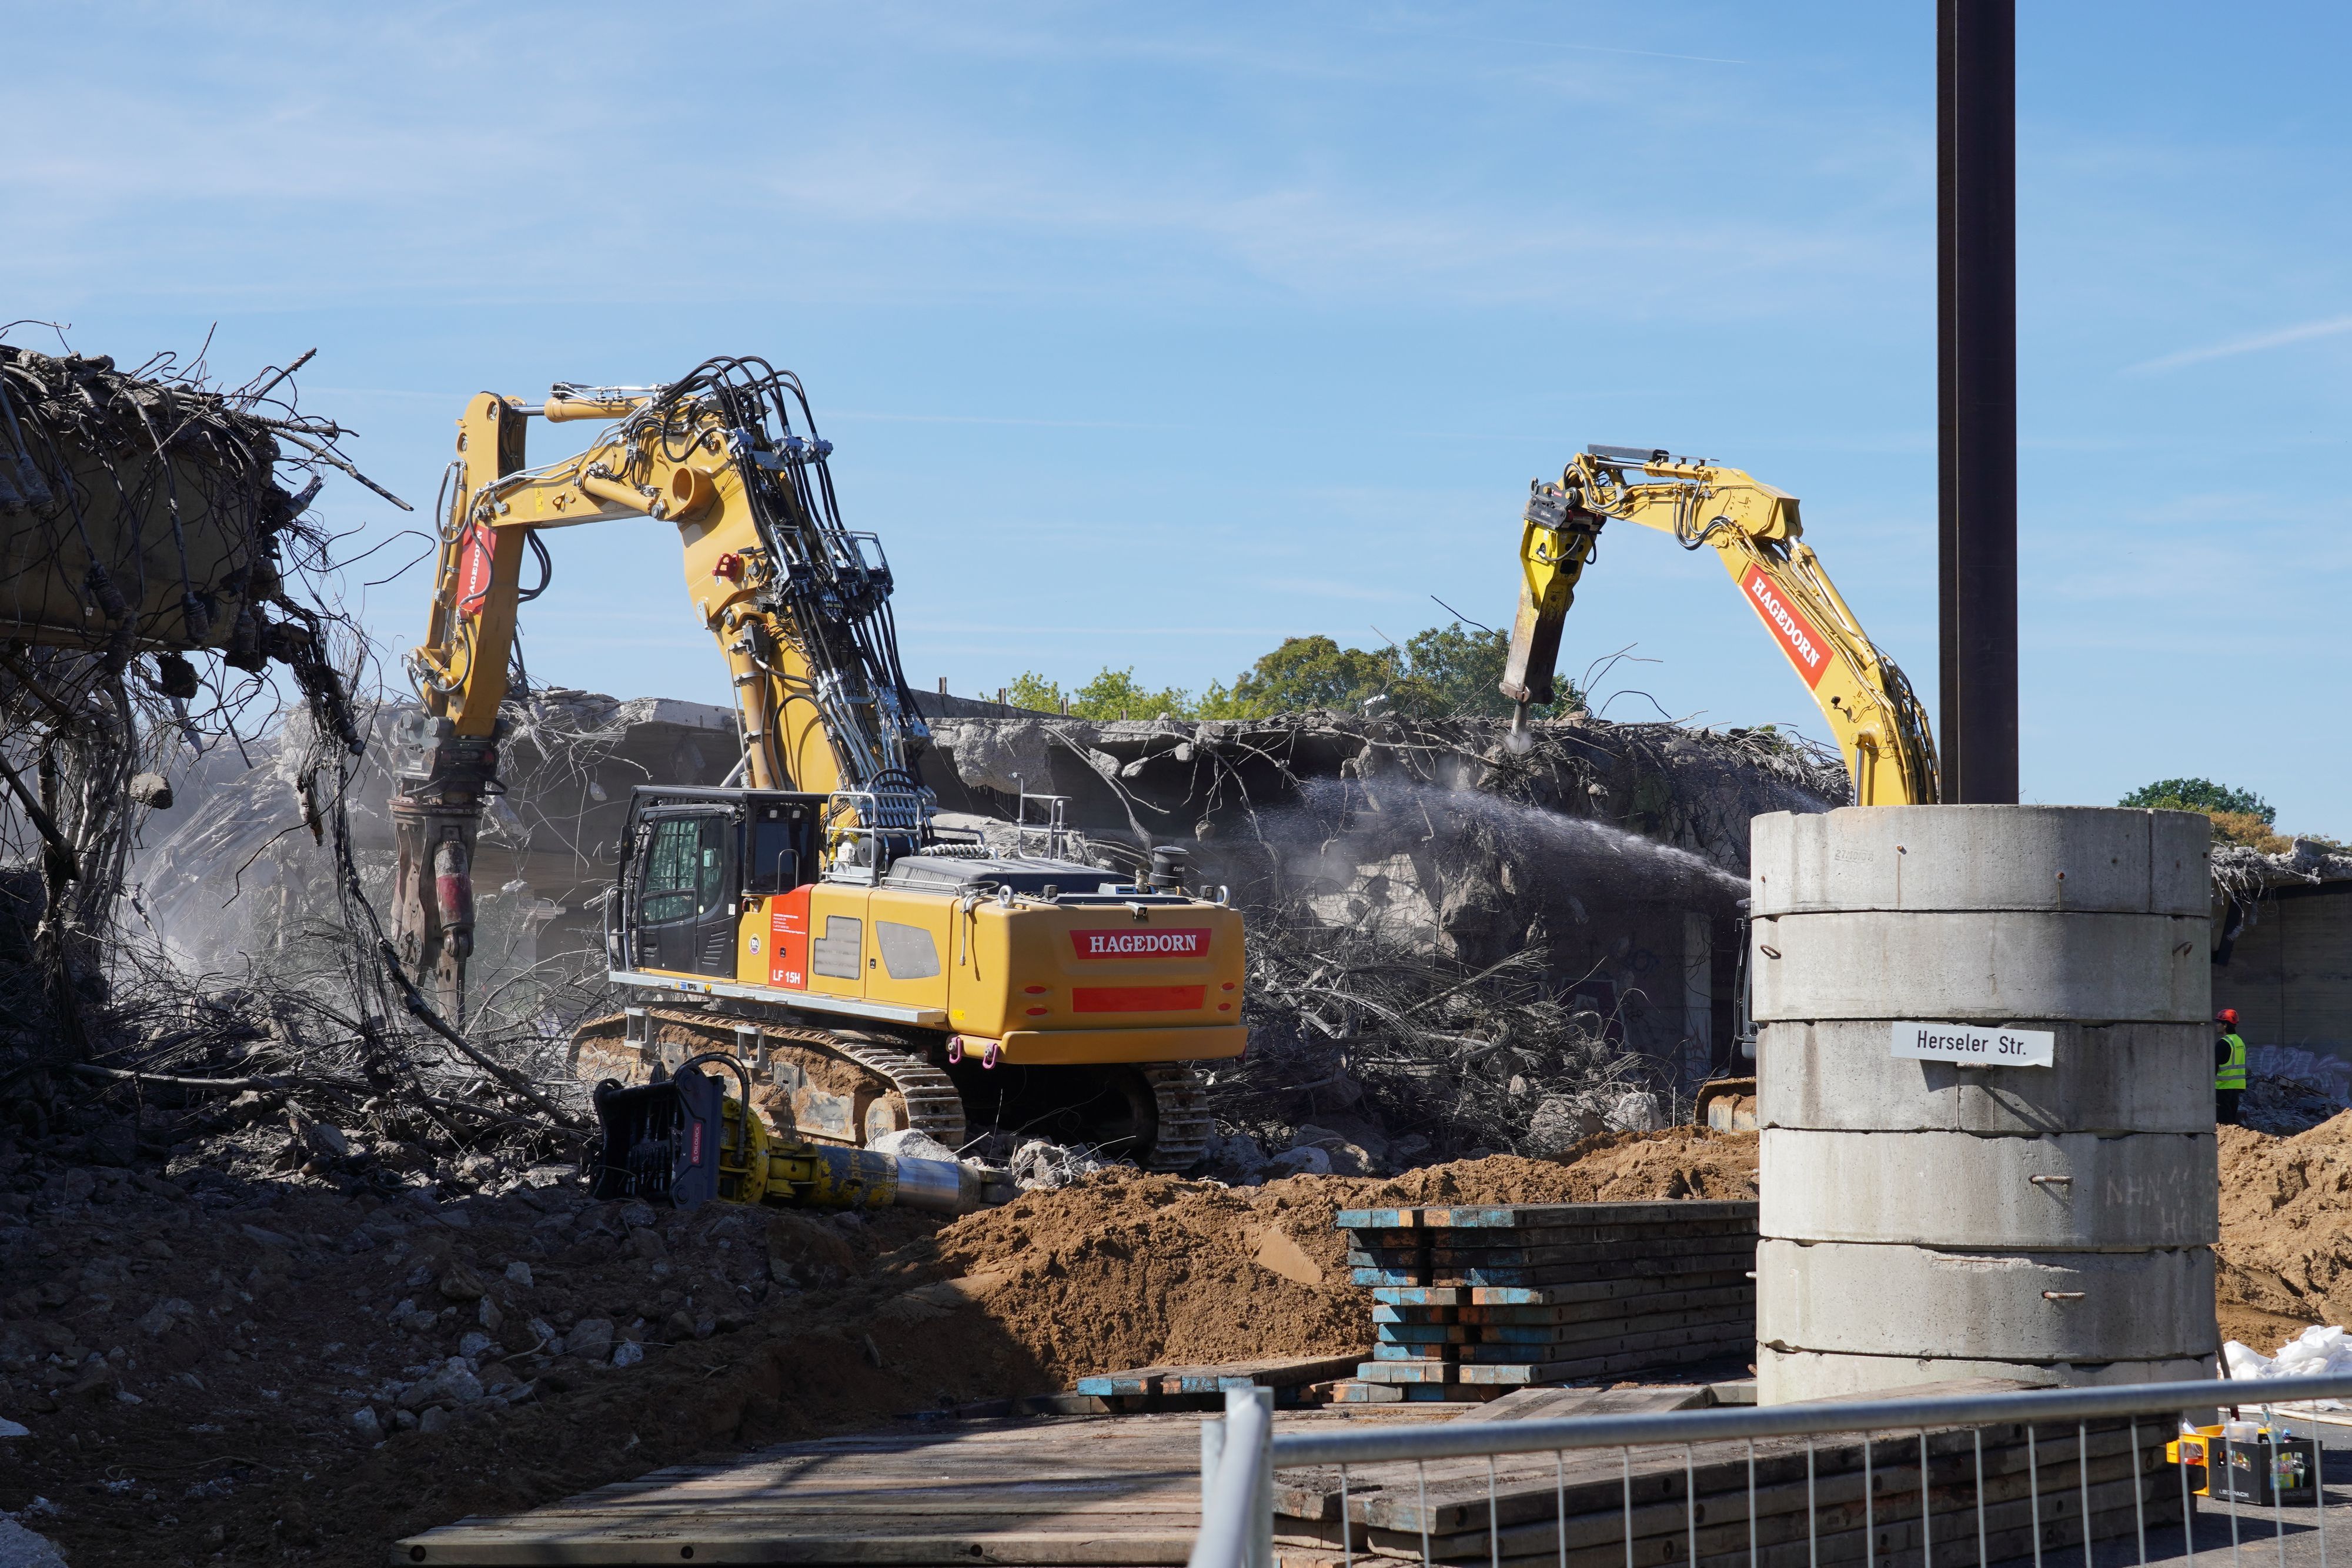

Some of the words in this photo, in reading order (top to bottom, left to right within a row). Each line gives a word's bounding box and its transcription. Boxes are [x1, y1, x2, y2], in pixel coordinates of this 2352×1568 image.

[1752, 577, 1820, 668] HAGEDORN
[1090, 935, 1197, 952] HAGEDORN
[773, 969, 784, 981] LF
[785, 971, 800, 984] 15H
[1917, 1030, 1989, 1052] Herseler
[1999, 1036, 2026, 1055] Str.
